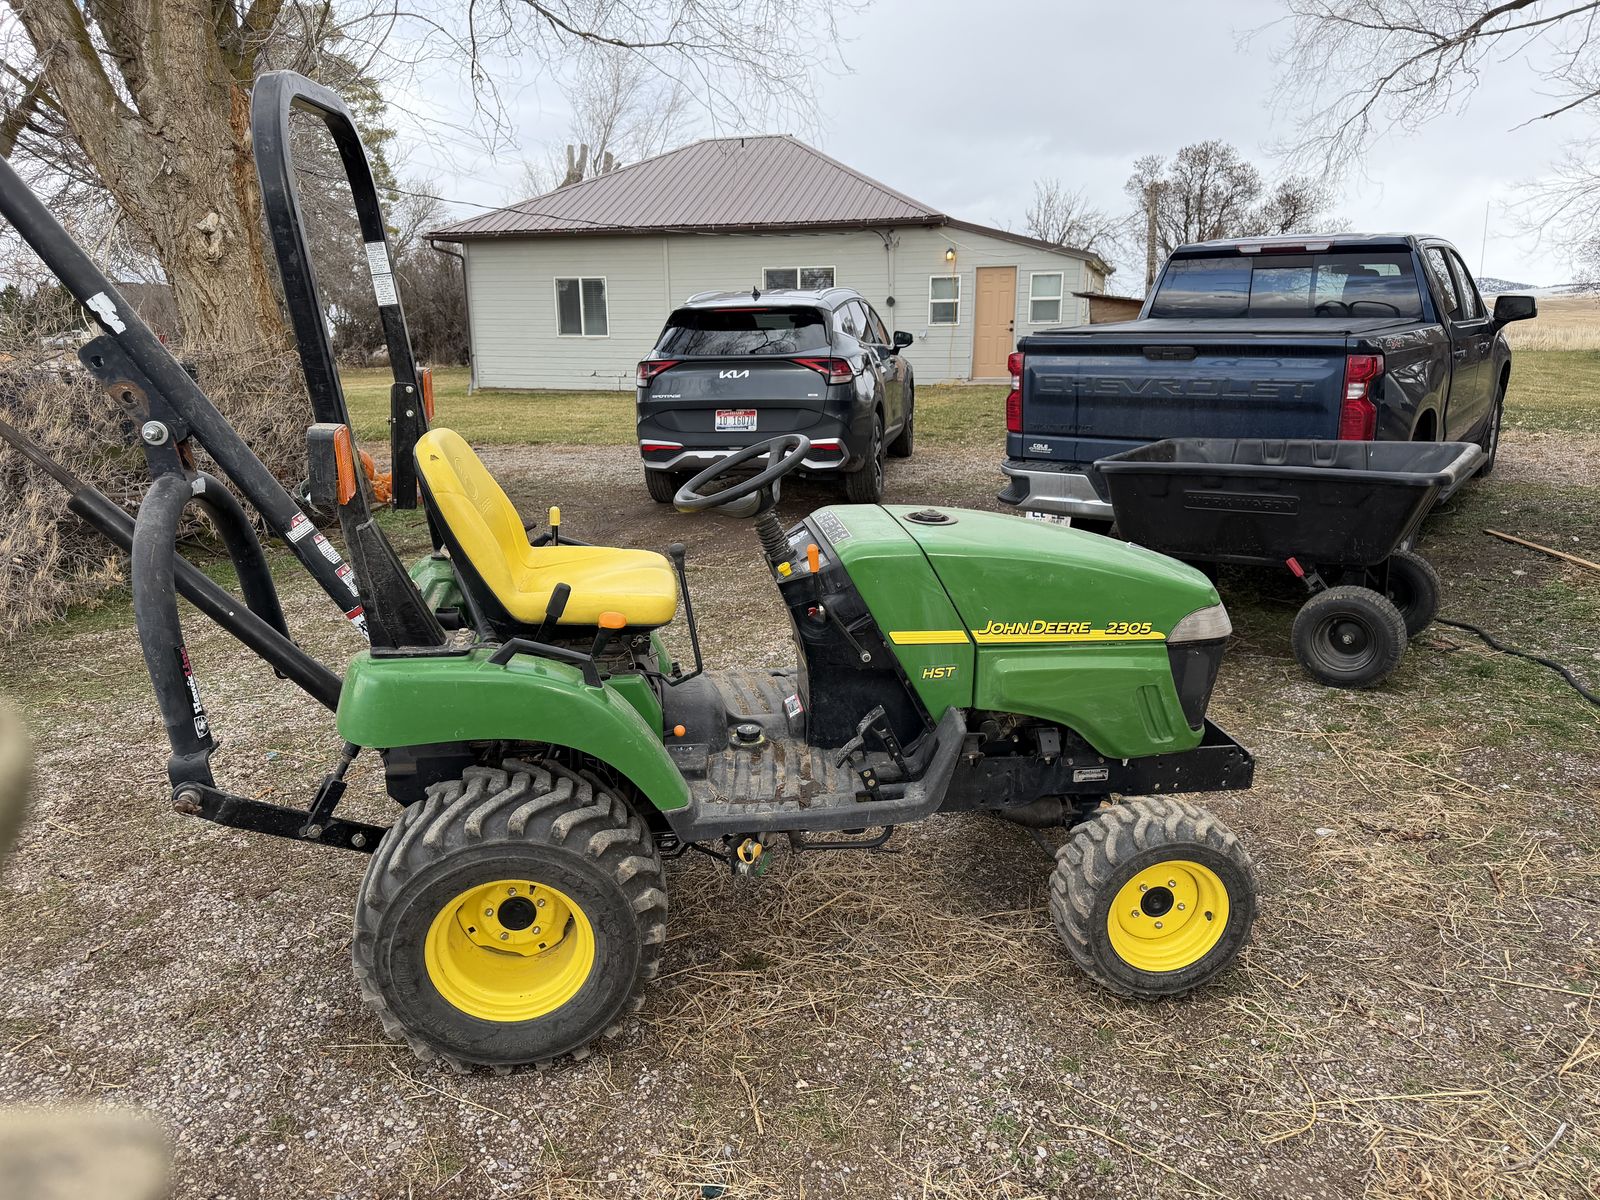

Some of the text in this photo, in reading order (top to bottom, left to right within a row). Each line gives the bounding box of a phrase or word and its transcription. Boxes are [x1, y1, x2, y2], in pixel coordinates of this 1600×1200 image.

[1037, 375, 1316, 399] CHEVROLET
[978, 620, 1153, 635] JOHN DEERE 2305
[921, 666, 956, 680] HST
